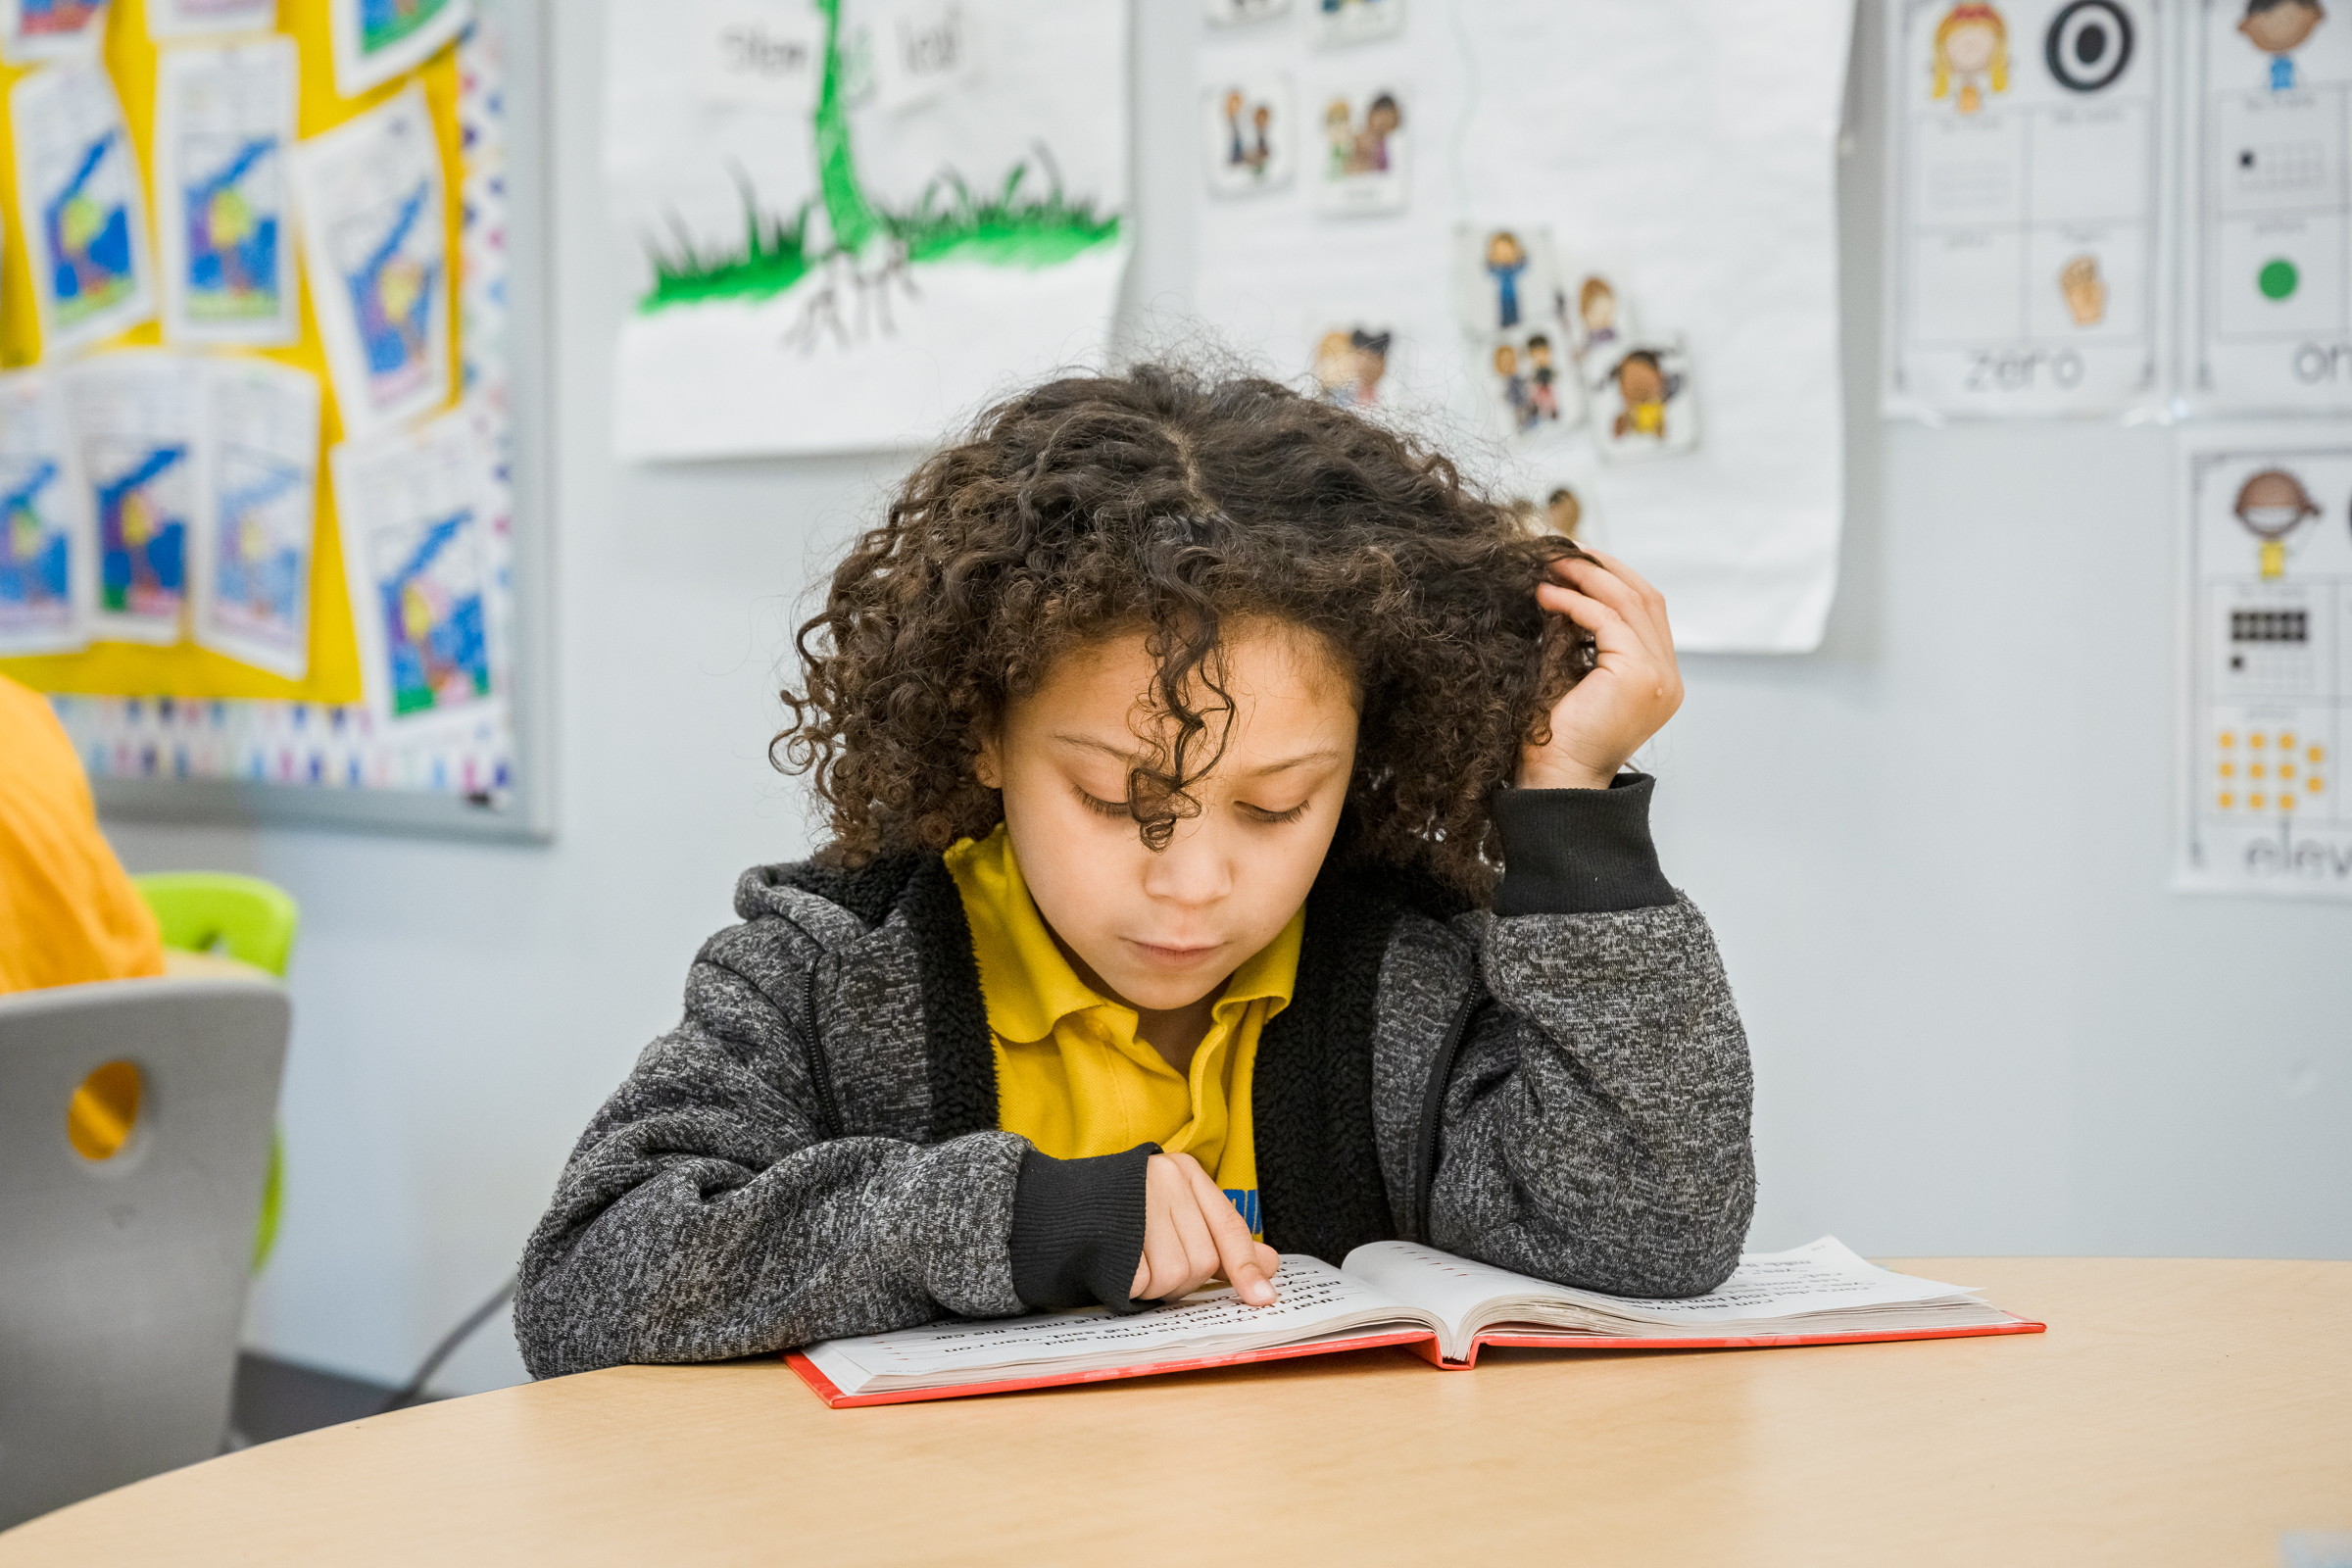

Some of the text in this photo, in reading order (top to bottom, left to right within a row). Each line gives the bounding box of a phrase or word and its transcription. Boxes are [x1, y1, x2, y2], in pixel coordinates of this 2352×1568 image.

[1965, 347, 2084, 391] zero
[1279, 1295, 1313, 1304] big
[1190, 1313, 1227, 1323] met
